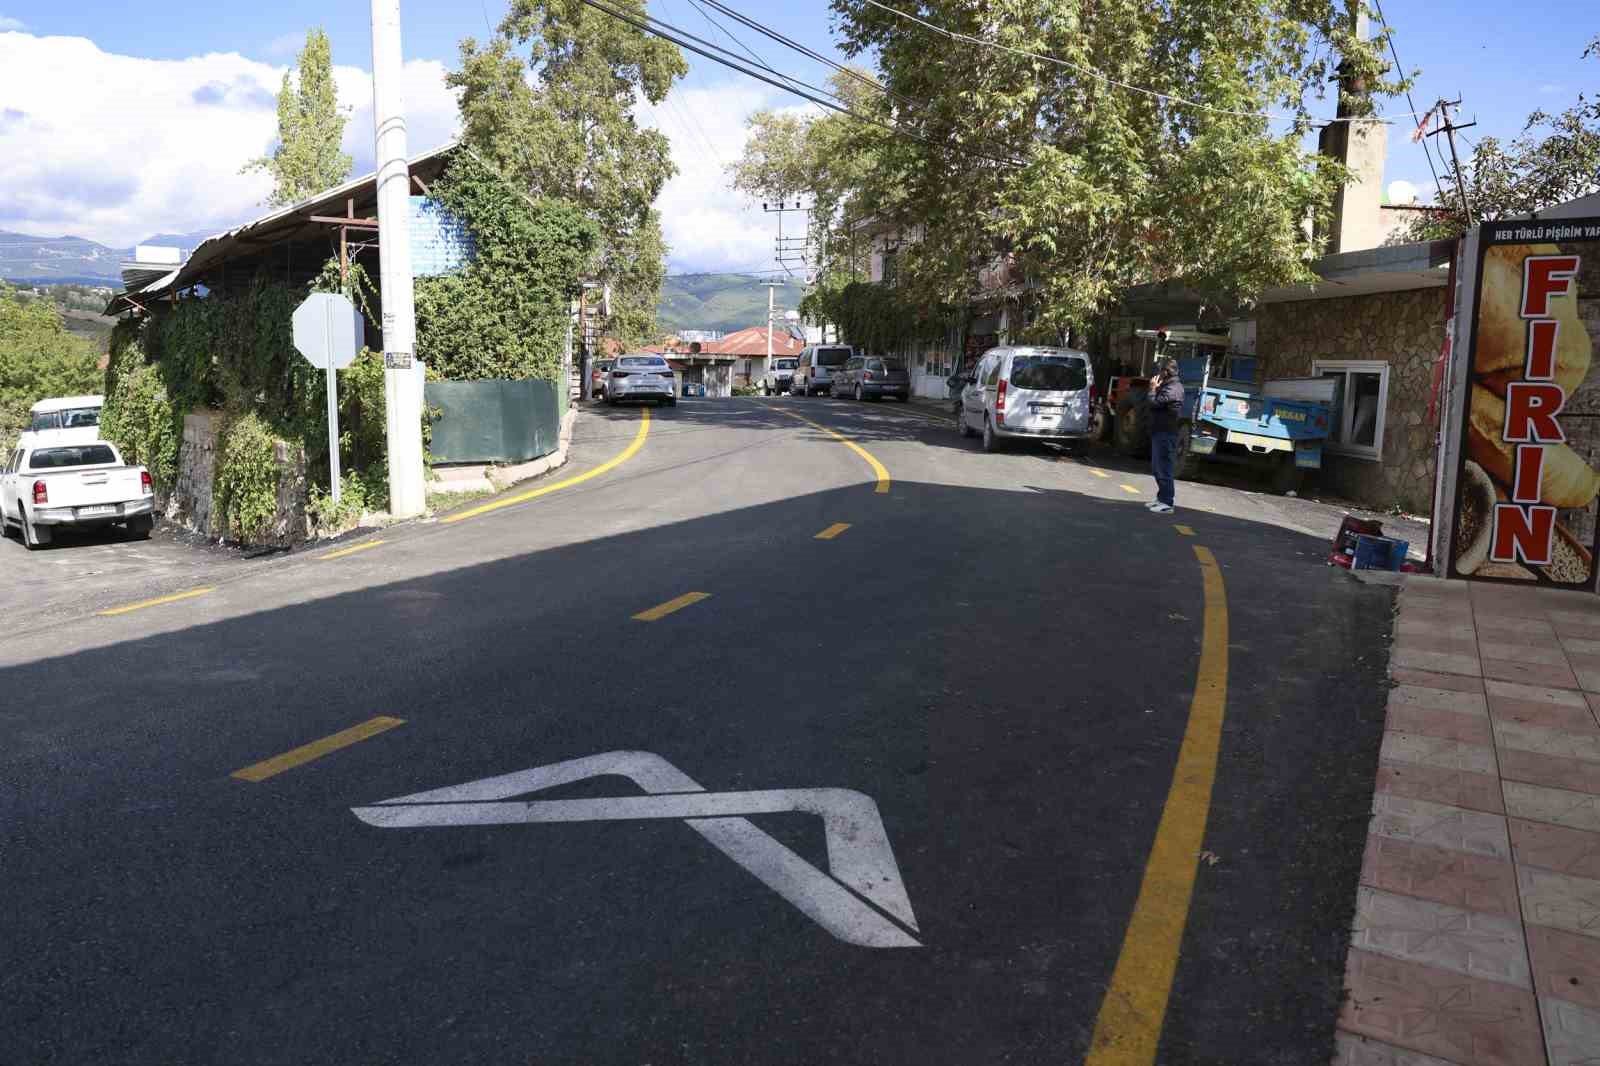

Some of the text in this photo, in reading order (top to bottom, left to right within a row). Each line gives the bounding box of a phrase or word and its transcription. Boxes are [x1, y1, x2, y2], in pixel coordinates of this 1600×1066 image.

[1495, 230, 1513, 240] HER
[1514, 227, 1544, 239] TÜRLÜ
[1545, 225, 1583, 240] PİŞİRİM
[1490, 255, 1580, 565] FIRIN
